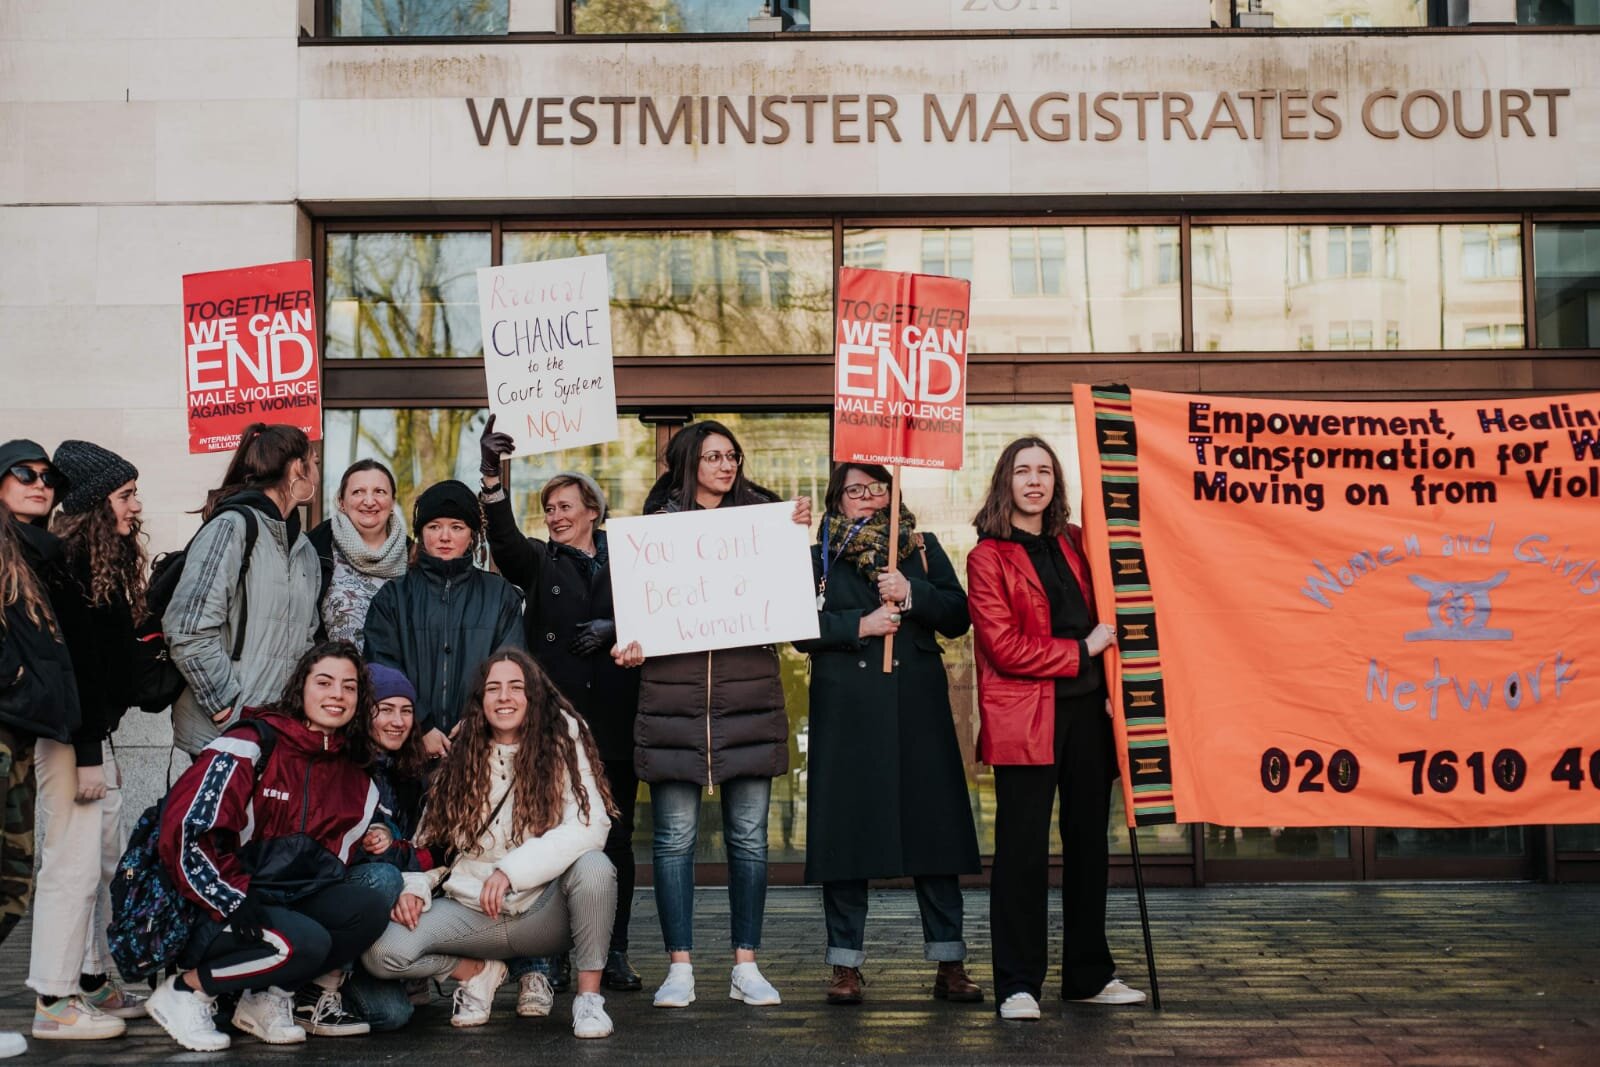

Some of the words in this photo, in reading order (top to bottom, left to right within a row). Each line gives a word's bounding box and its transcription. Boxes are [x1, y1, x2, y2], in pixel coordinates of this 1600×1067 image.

[465, 93, 902, 146] WESTMINSTER
[923, 89, 1341, 143] MAGISTRATES
[1361, 87, 1571, 140] COURT
[186, 290, 311, 322] TOGETHER
[491, 271, 586, 311] Radical
[188, 317, 238, 344] WE
[248, 308, 313, 337] CAN
[491, 308, 600, 357] CHANGE
[841, 299, 966, 329] TOGETHER
[841, 319, 892, 348] WE
[902, 325, 963, 354] CAN
[188, 332, 314, 392] END
[528, 360, 539, 373] to
[546, 356, 565, 371] the
[838, 343, 961, 404] END
[189, 389, 236, 407] MALE
[240, 380, 317, 401] VIOLENCE
[190, 401, 255, 420] AGAINST
[260, 394, 317, 412] WOMEN
[497, 378, 544, 406] Court
[554, 376, 604, 406] System
[837, 397, 884, 415] MALE
[887, 400, 962, 422] VIOLENCE
[526, 407, 583, 447] NOW
[838, 411, 900, 429] AGAINST
[905, 416, 962, 434] WOMEN
[1189, 401, 1456, 442] Empowerment,
[1477, 403, 1600, 434] Healin
[1188, 435, 1476, 479] Transformation
[1497, 439, 1549, 475] for
[1193, 471, 1325, 512] Moving
[1345, 482, 1389, 506] on
[1411, 474, 1497, 505] from
[626, 530, 675, 568] You
[1301, 533, 1422, 609] Women
[1440, 519, 1497, 557] and
[1513, 533, 1600, 595] Girls
[643, 575, 711, 615] Beat
[1366, 650, 1580, 721] Network
[1260, 747, 1360, 793] 020
[1398, 747, 1528, 796] 7610
